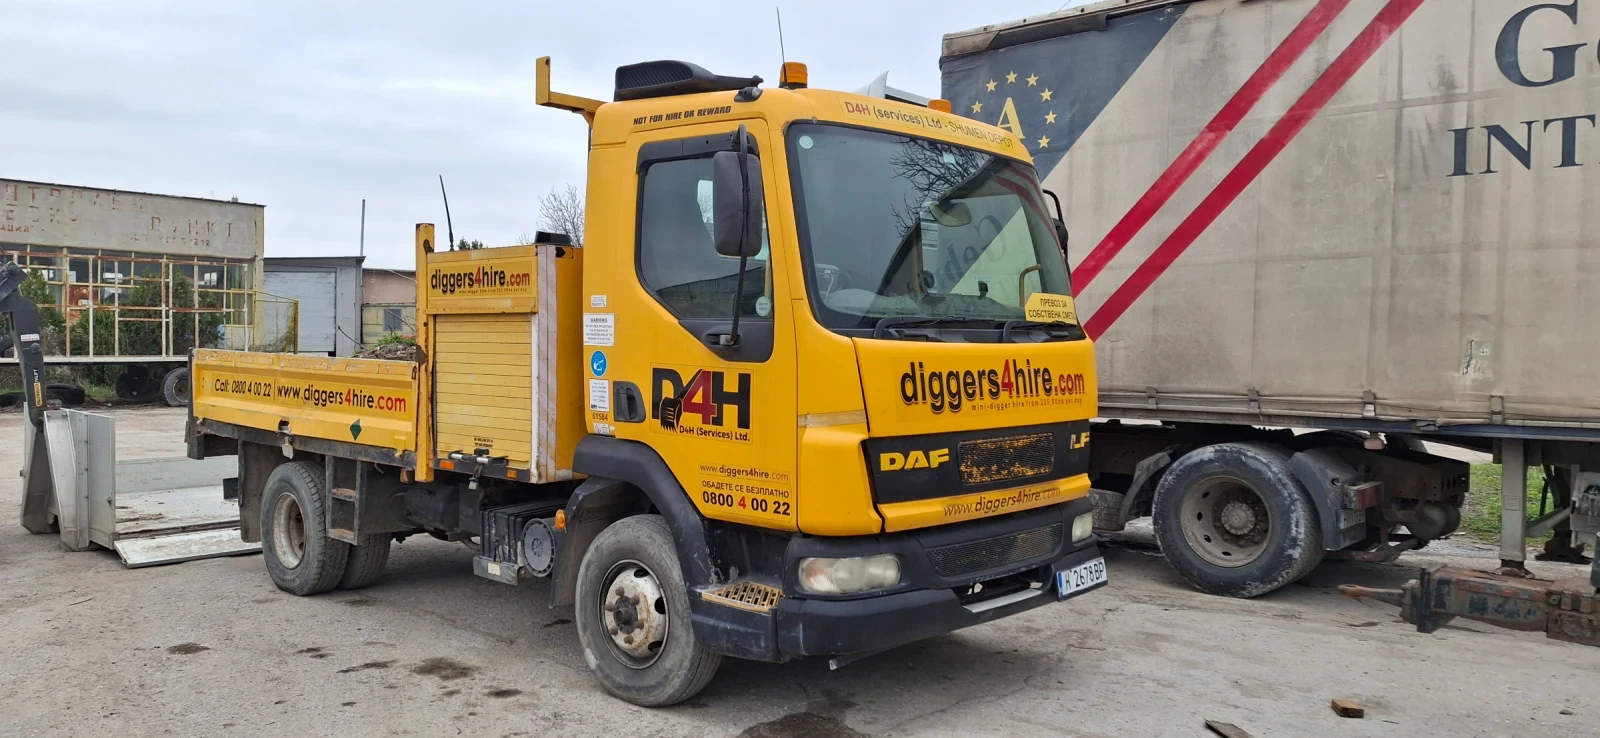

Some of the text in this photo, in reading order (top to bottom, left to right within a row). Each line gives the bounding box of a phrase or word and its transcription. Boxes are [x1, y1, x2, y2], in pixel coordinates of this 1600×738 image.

[633, 106, 731, 125] NOT FOR HIRE OR REWARD
[844, 101, 870, 116] D4H
[873, 107, 924, 128] (services)
[926, 116, 941, 129] Ltd
[949, 122, 987, 141] SHUMEN
[988, 133, 1014, 149] DEPOT
[996, 97, 1025, 139] A
[431, 266, 530, 295] diggers4hire.com
[1040, 298, 1068, 308] ПРЕВОЗ ЗА
[1028, 309, 1061, 319] СОБСТВЕНА
[215, 378, 406, 412] Call: 0800 4 00 22 www.diggers4hire.com
[900, 359, 1086, 413] diggers4hire.com
[651, 367, 751, 428] D4H
[971, 402, 1011, 411] mini-digger
[1012, 400, 1024, 408] hire
[1025, 399, 1039, 407] from
[1065, 397, 1073, 405] per
[1074, 396, 1083, 405] day
[592, 412, 609, 421] 61584
[679, 425, 750, 441] D4H (Services) Ltd.
[1069, 432, 1089, 450] LF
[880, 448, 949, 472] DAF
[699, 464, 789, 481] www.diggers4hire.com
[702, 480, 789, 498] ОБАДЕТЕ СЕ БЕЗПЛАТНО
[702, 490, 791, 516] 0800 4 00 22
[943, 487, 1061, 516] www.diggers4hire.com
